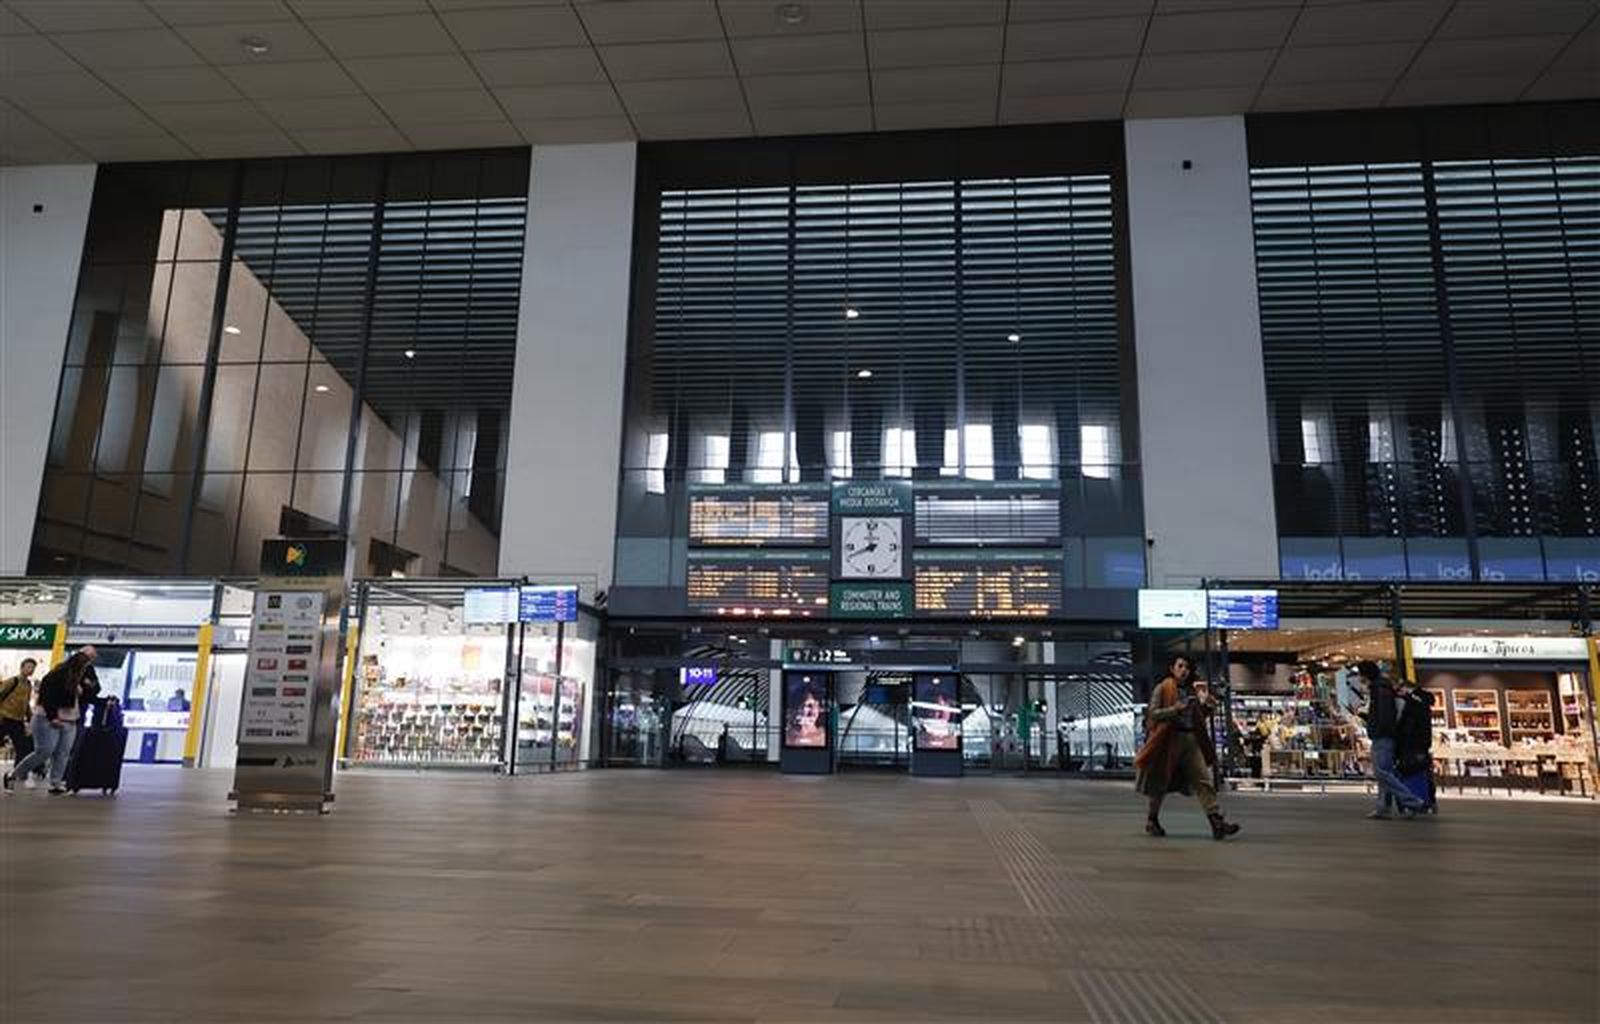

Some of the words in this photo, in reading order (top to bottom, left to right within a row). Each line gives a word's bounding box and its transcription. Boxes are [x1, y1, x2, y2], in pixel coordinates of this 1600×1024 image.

[864, 497, 900, 507] DISTANCIA
[843, 590, 882, 600] COMMUTER
[883, 590, 901, 600] AND
[841, 600, 876, 611] REGIONAL
[878, 600, 903, 611] TRAINS
